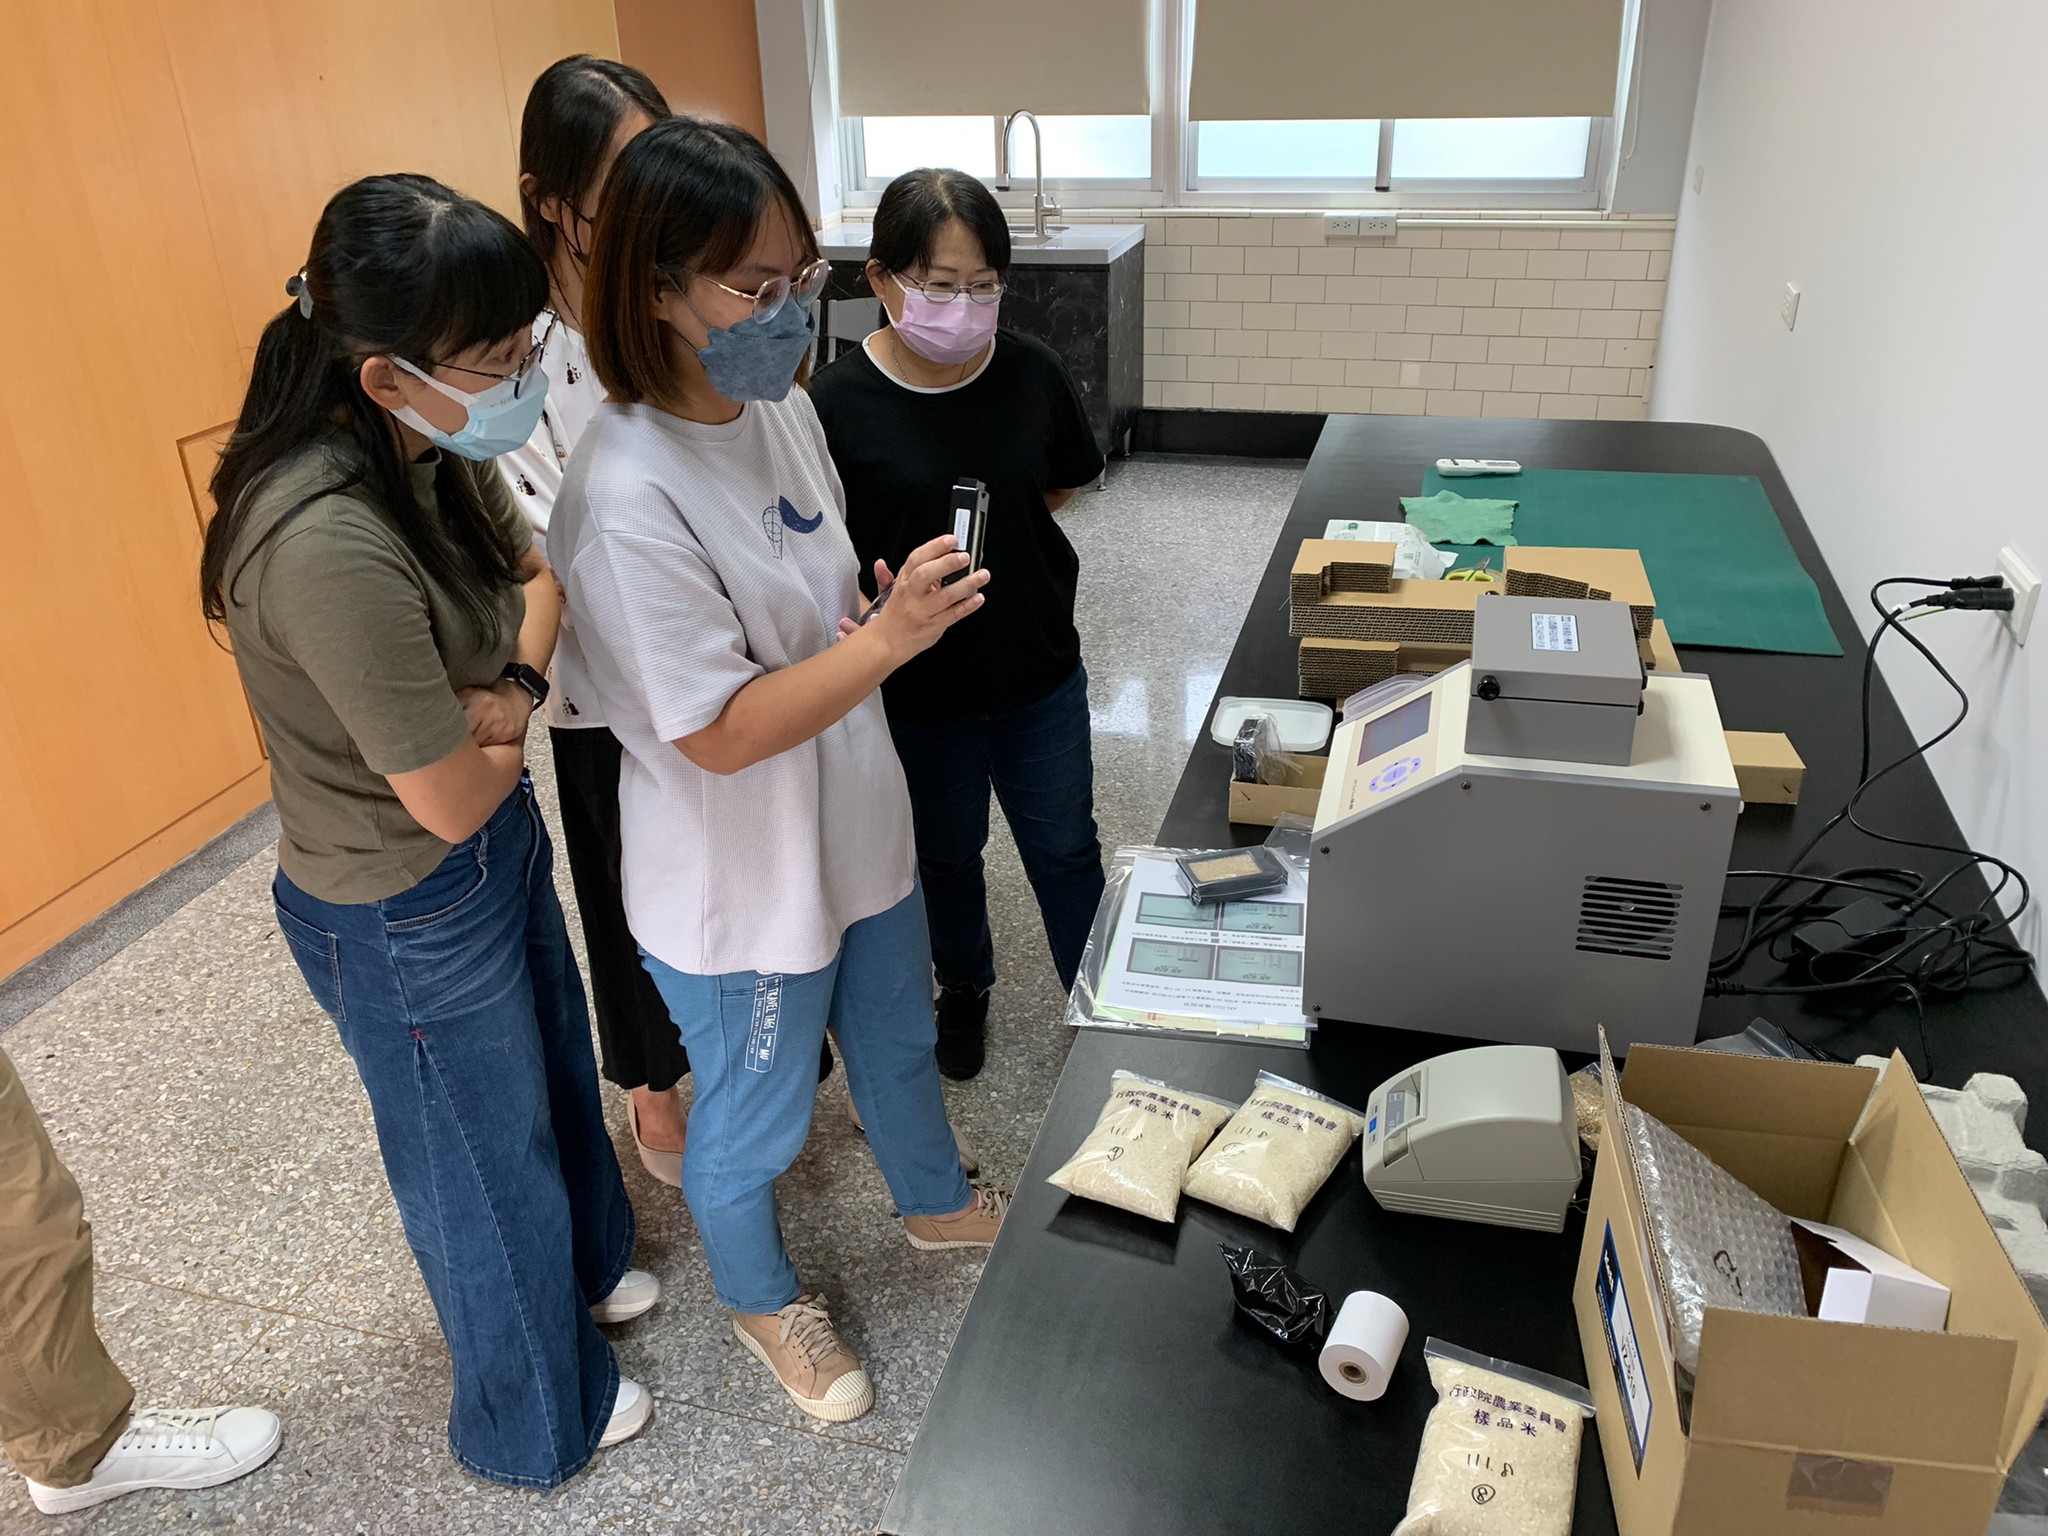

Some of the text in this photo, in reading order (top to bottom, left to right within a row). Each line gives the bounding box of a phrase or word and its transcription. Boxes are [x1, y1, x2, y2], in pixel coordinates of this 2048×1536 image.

[766, 987, 779, 1013] TRAVEL
[763, 1013, 776, 1030] TAGS
[1116, 1090, 1202, 1118] 行政院農業委員會
[1128, 1098, 1175, 1121] 樣品米
[1250, 1098, 1338, 1131] 行政院農業委員會
[1261, 1111, 1306, 1133] 樣品米
[1449, 1384, 1567, 1433] 行政院農業委員會
[1473, 1408, 1537, 1437] 樣品米
